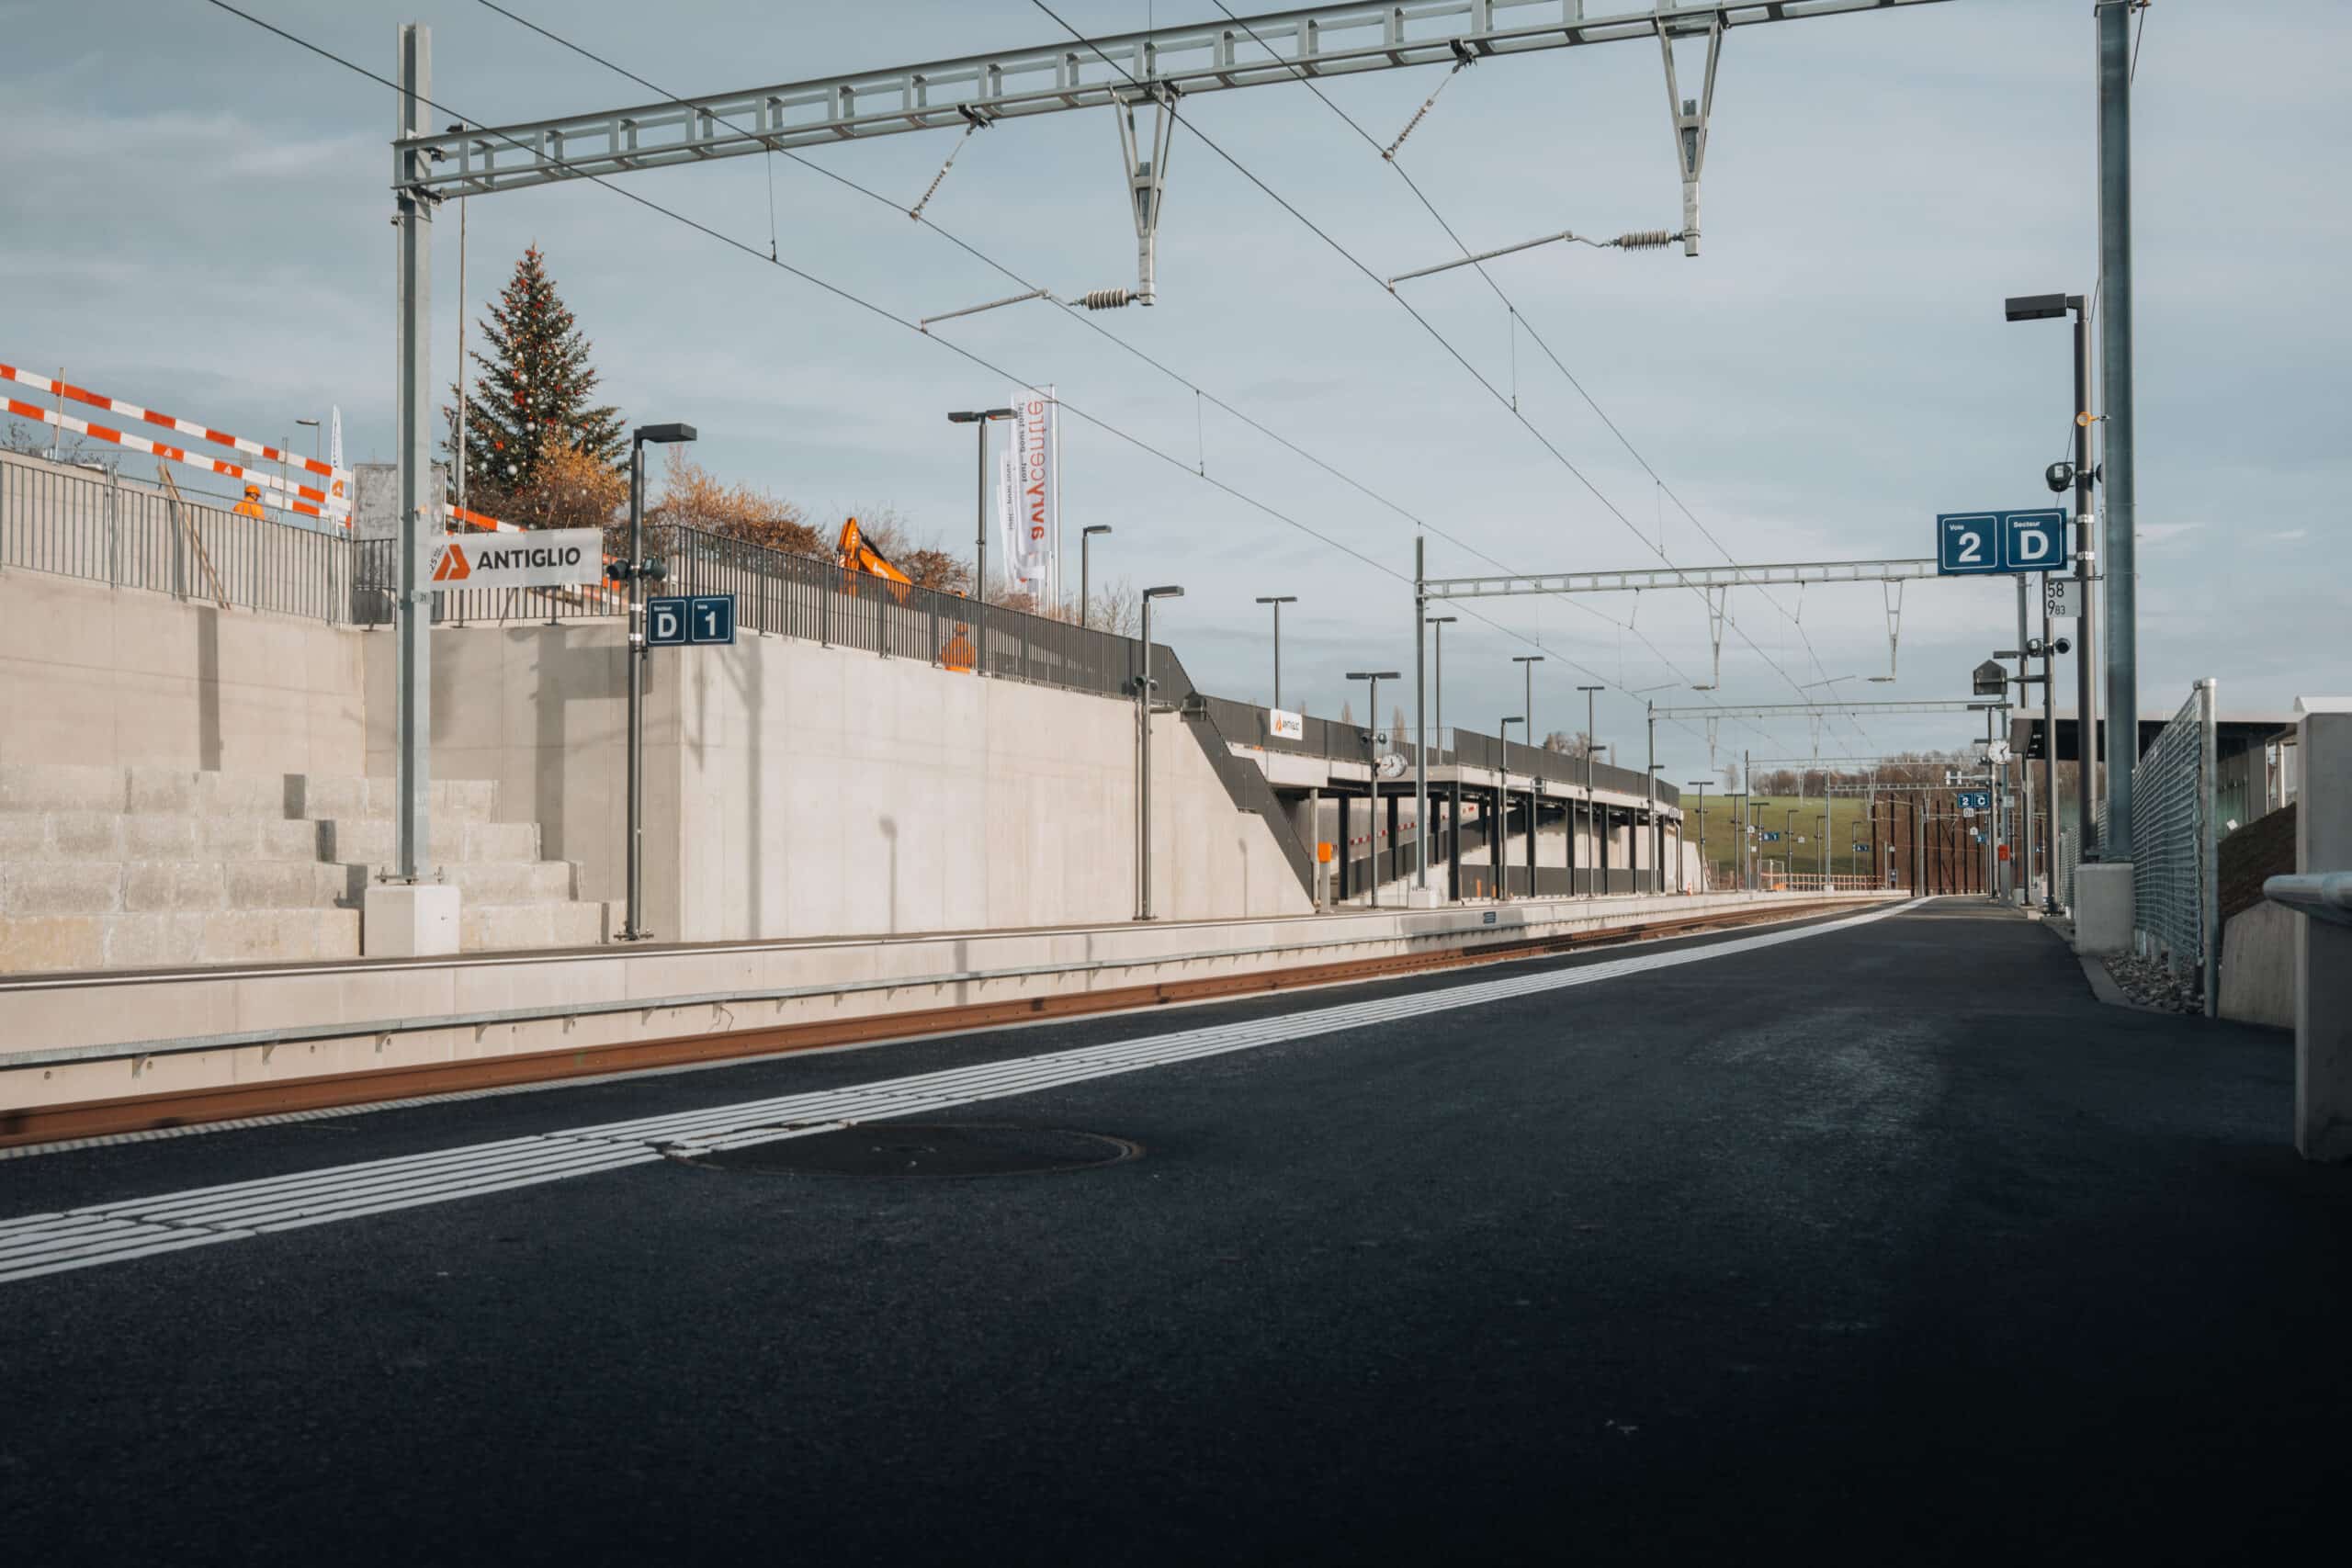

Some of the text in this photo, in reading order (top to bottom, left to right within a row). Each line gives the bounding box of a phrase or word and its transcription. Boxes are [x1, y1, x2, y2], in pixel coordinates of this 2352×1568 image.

[1958, 531, 1982, 563] 2
[2020, 529, 2049, 560] D
[477, 547, 581, 570] ANTIGLIO
[2048, 581, 2064, 598] 58
[657, 613, 677, 638] D
[705, 611, 716, 637] 1
[1962, 796, 1970, 807] 2
[1977, 796, 1985, 807] C
